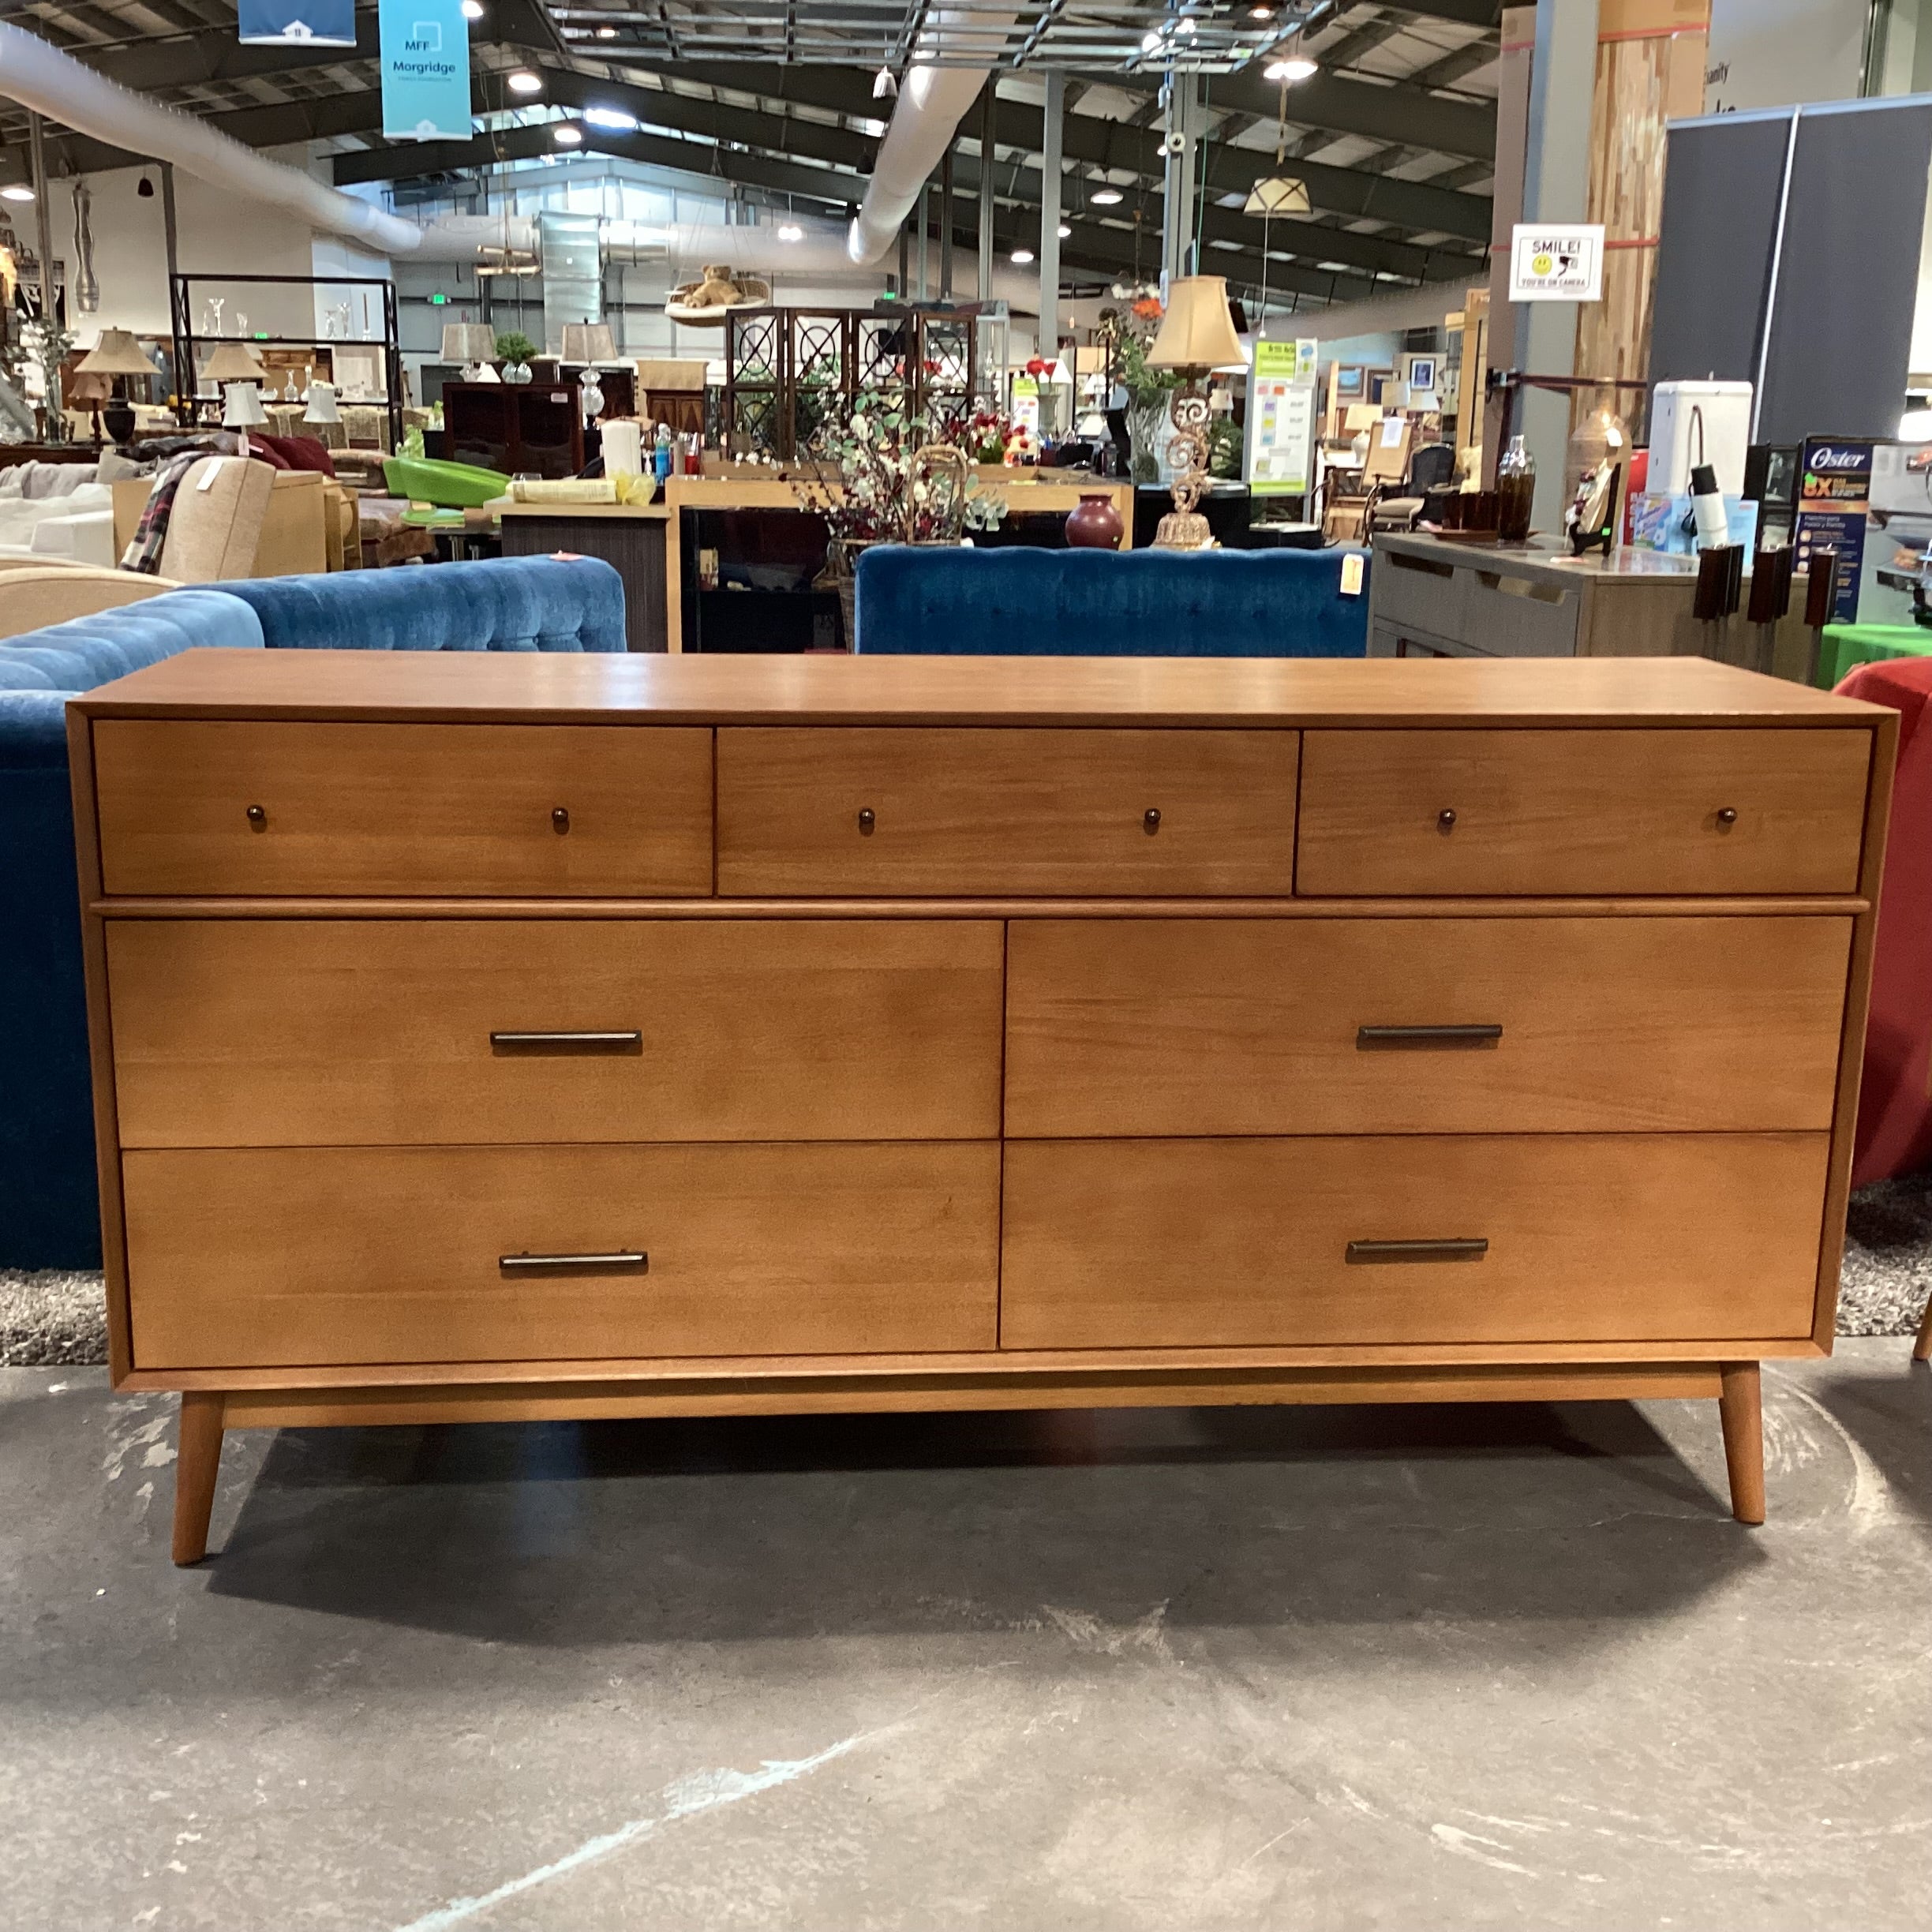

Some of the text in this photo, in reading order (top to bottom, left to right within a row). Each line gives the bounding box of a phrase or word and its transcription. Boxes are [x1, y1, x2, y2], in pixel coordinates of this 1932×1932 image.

[405, 40, 429, 51] MFF
[393, 61, 455, 75] Morgridge
[1532, 240, 1581, 254] SMILE!
[1810, 447, 1866, 469] Oster
